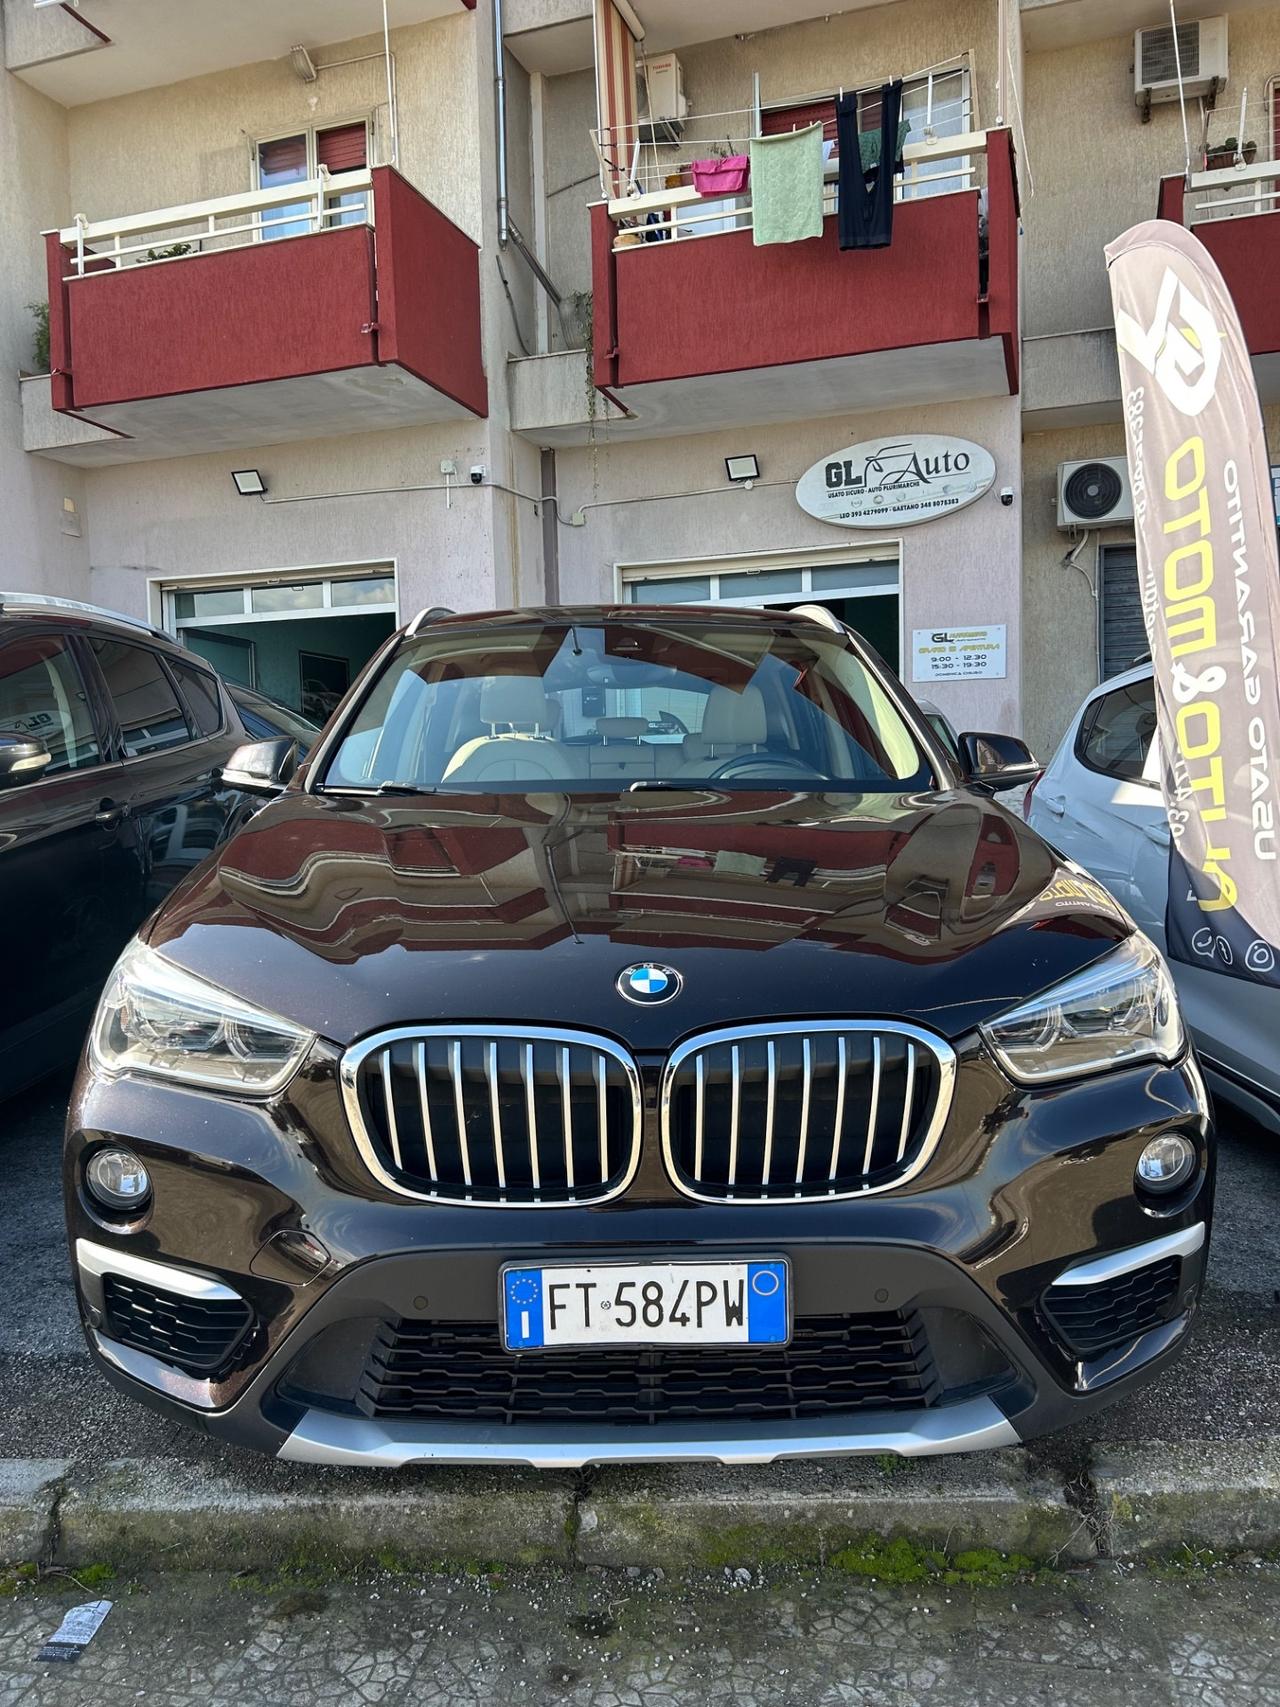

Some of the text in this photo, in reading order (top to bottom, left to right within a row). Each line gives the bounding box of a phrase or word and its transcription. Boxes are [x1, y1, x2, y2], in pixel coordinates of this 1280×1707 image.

[825, 450, 970, 488] GL Auto
[827, 490, 845, 499] USATO
[845, 488, 865, 497] SICURO
[867, 486, 882, 494] AUTO
[882, 481, 920, 491] PLURIMARCHE
[892, 503, 919, 512] GAETANO
[931, 632, 955, 643] GL
[548, 1279, 745, 1330] FT 584PW
